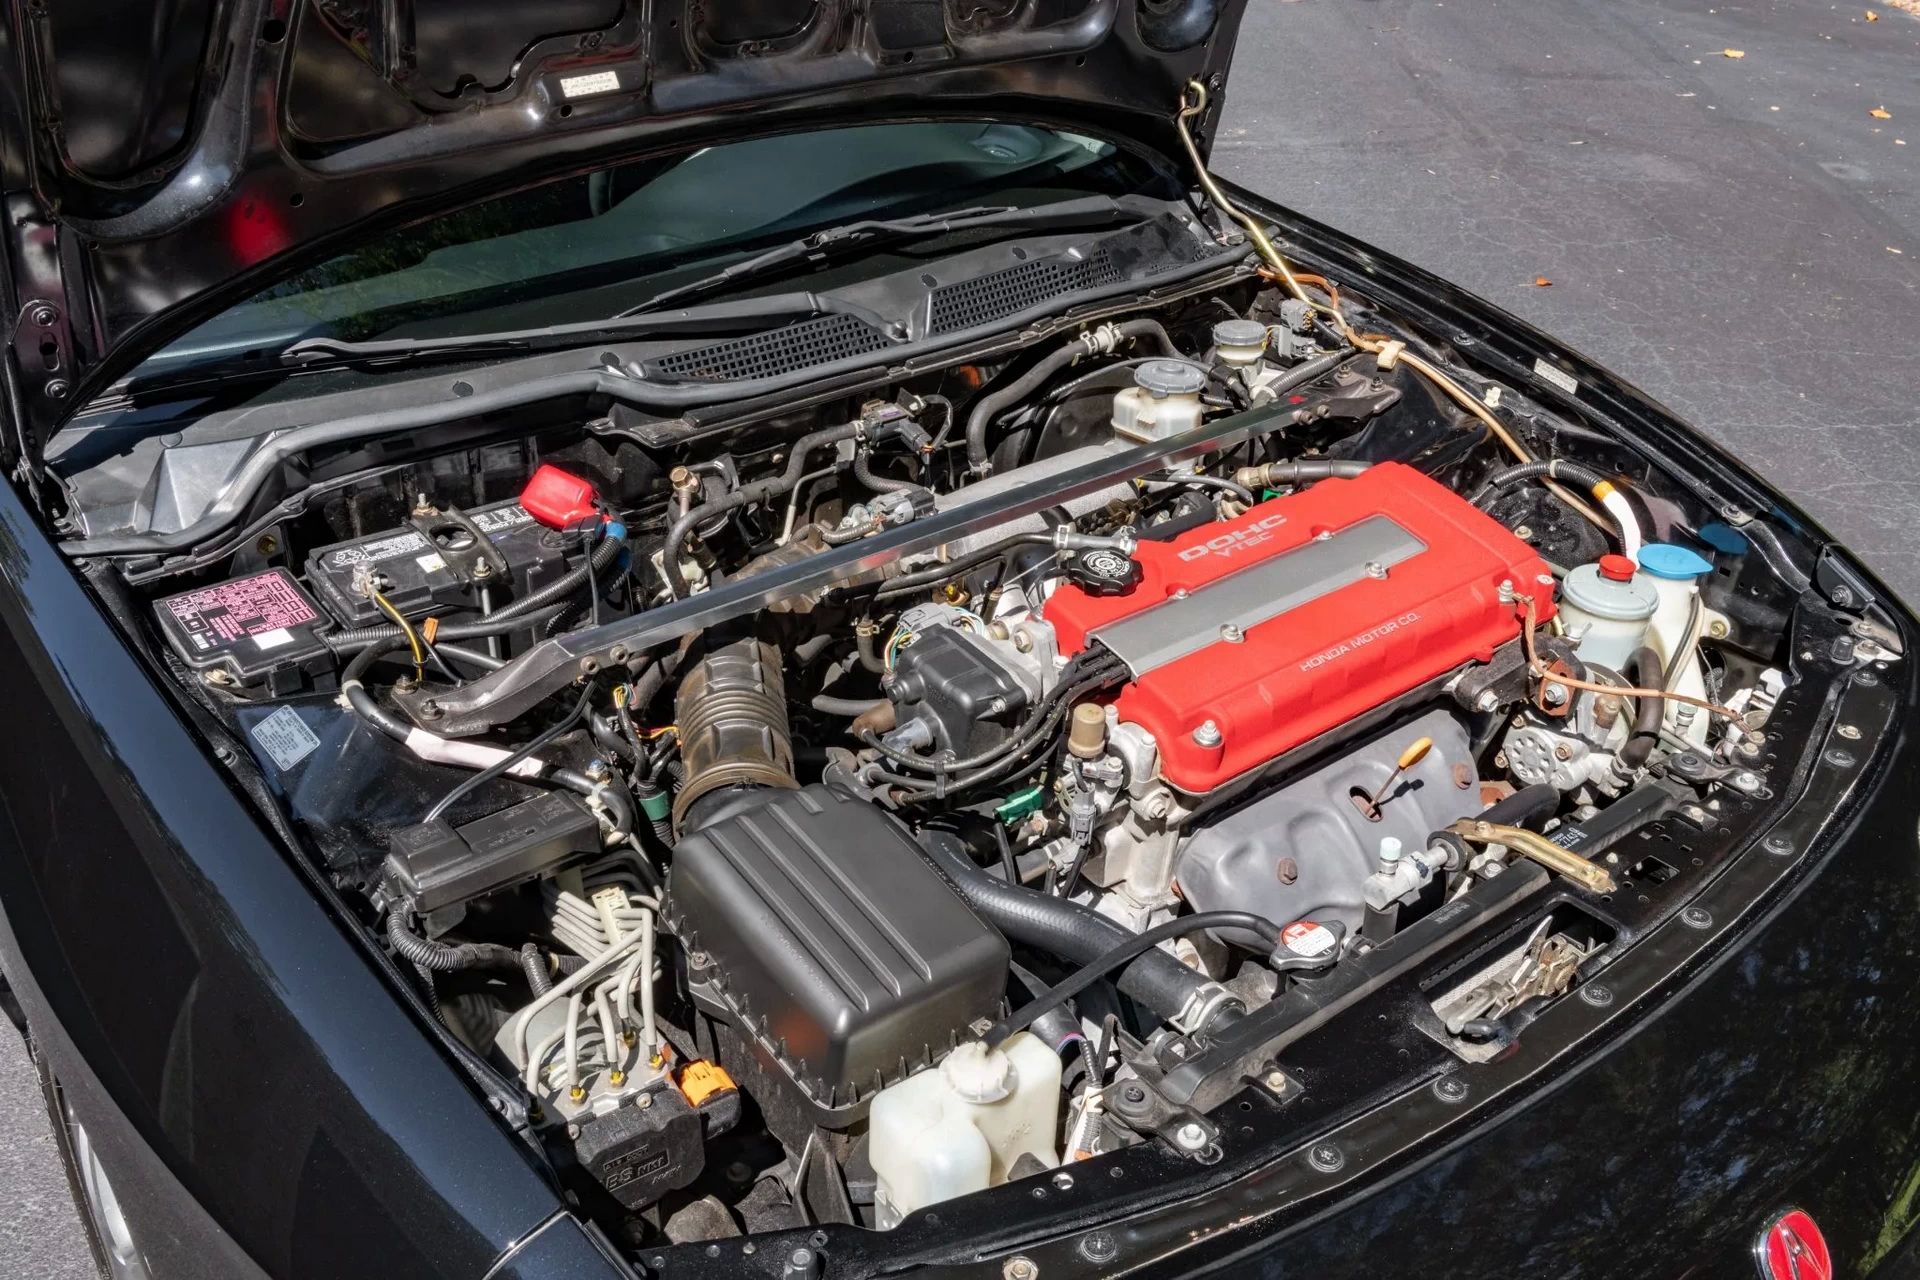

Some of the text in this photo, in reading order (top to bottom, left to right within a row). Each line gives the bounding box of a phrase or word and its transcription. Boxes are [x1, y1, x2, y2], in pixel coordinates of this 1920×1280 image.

[1178, 514, 1287, 562] DOHC
[1214, 531, 1274, 557] VTEC
[1299, 612, 1421, 672] HONDA MOTOR CO.
